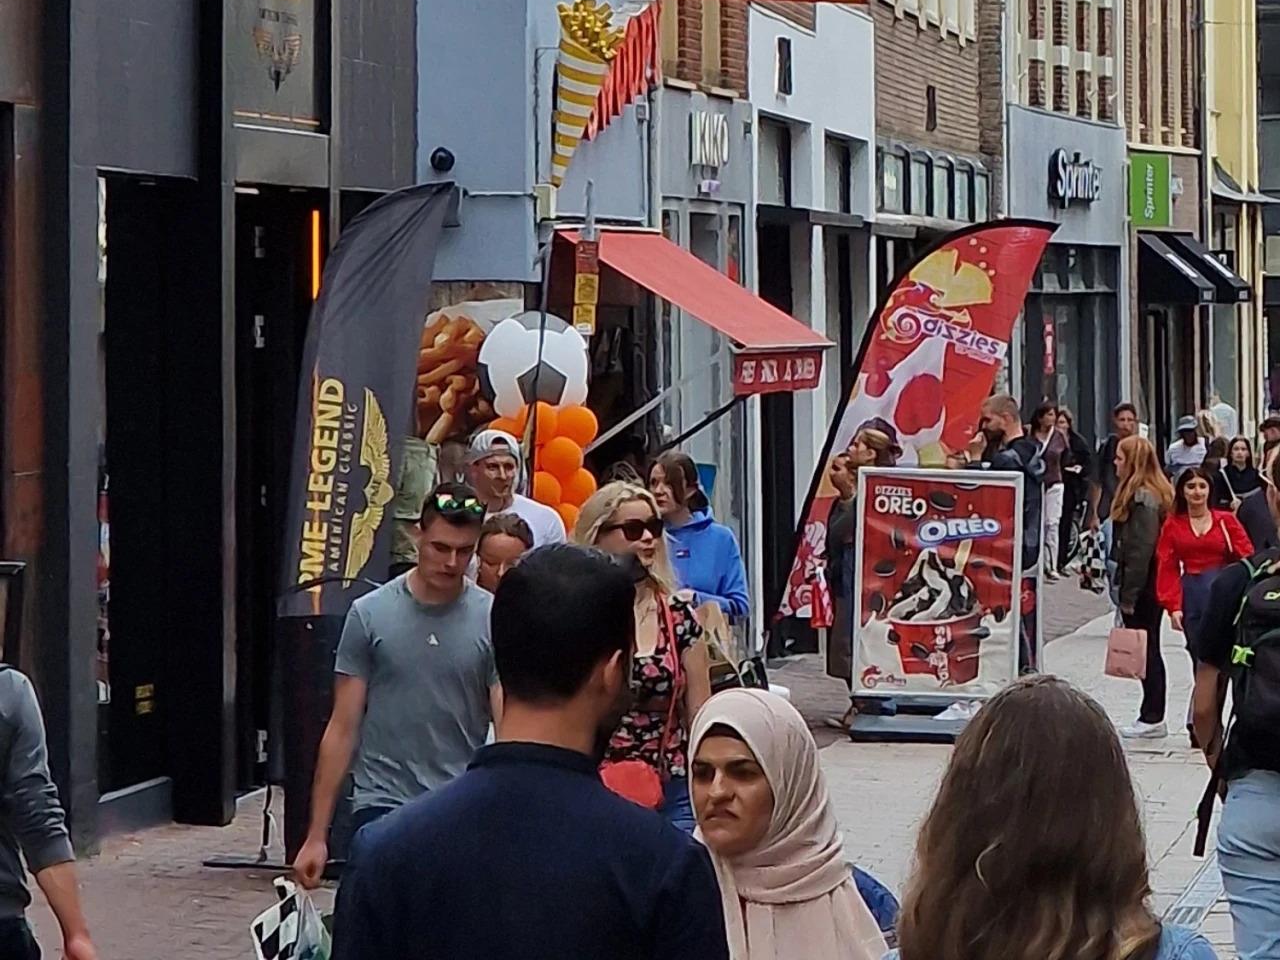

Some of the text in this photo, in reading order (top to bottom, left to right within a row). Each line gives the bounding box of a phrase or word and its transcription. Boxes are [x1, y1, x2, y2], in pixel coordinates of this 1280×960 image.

[1144, 163, 1156, 221] Sprinter
[923, 317, 1000, 355] dizzies
[306, 377, 346, 512] LEGEND
[327, 401, 360, 573] AMERICAN CLASSIC
[874, 495, 928, 518] OREO
[919, 518, 1001, 544] OREO
